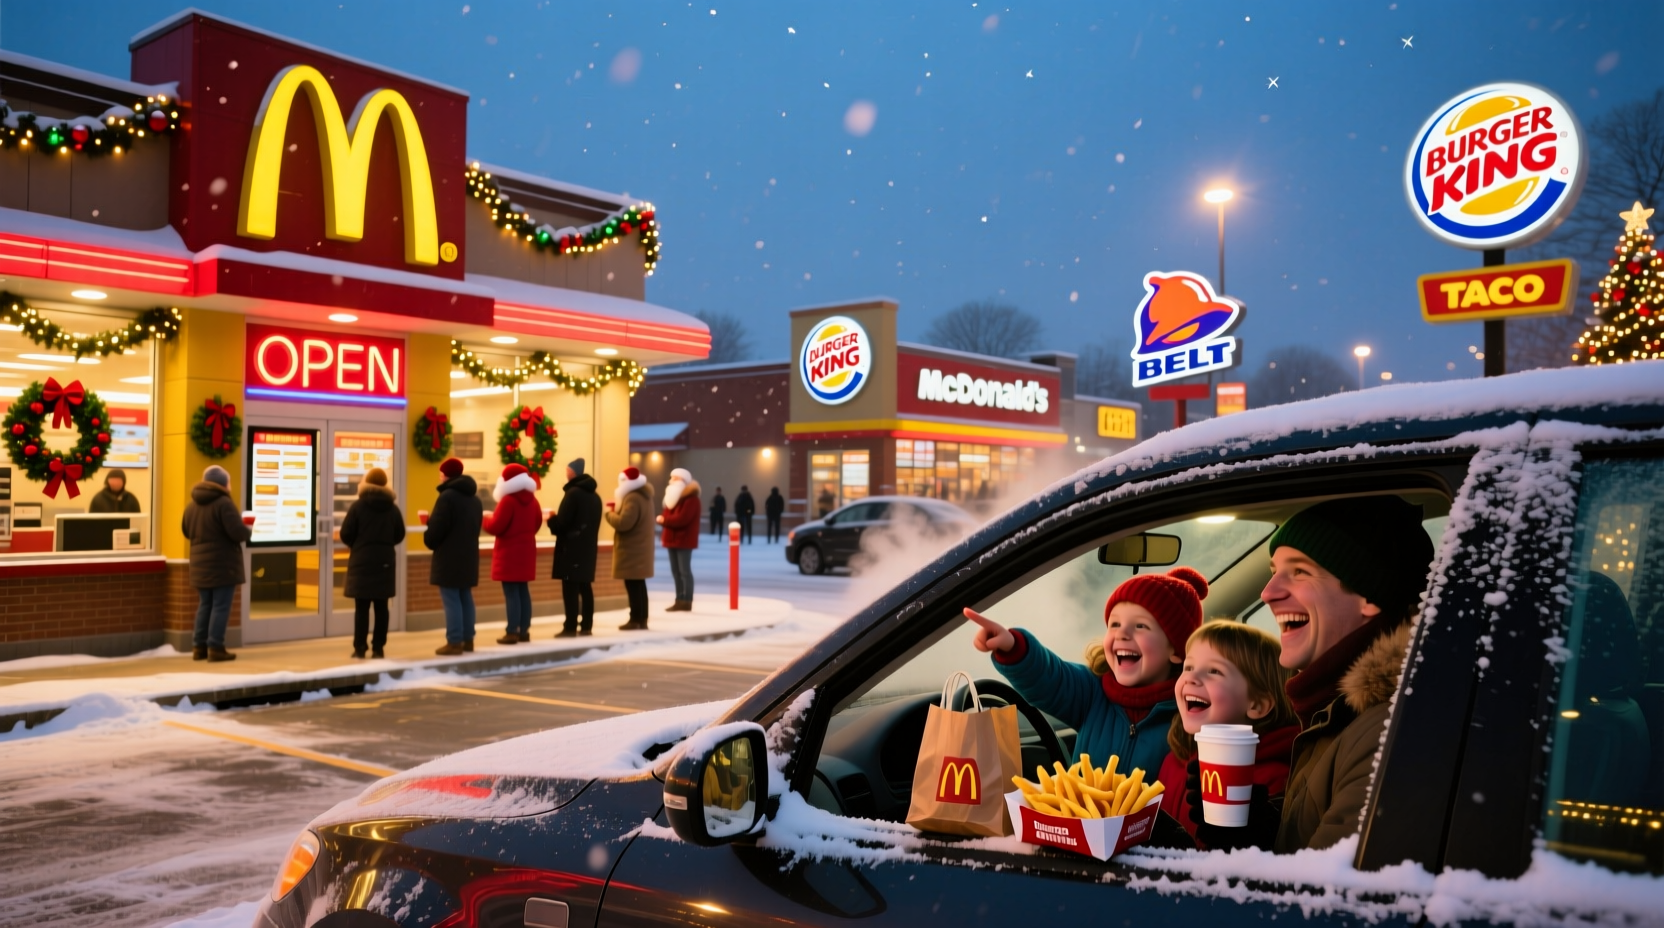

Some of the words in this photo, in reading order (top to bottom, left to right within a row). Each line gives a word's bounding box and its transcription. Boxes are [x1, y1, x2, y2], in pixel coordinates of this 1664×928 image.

[1426, 107, 1553, 177] BURGER
[1431, 132, 1558, 212] KING
[1440, 274, 1545, 309] TACO
[256, 335, 400, 393] OPEN
[811, 346, 860, 383] KING
[1138, 342, 1220, 381] BELT
[917, 368, 1049, 414] McDonald's
